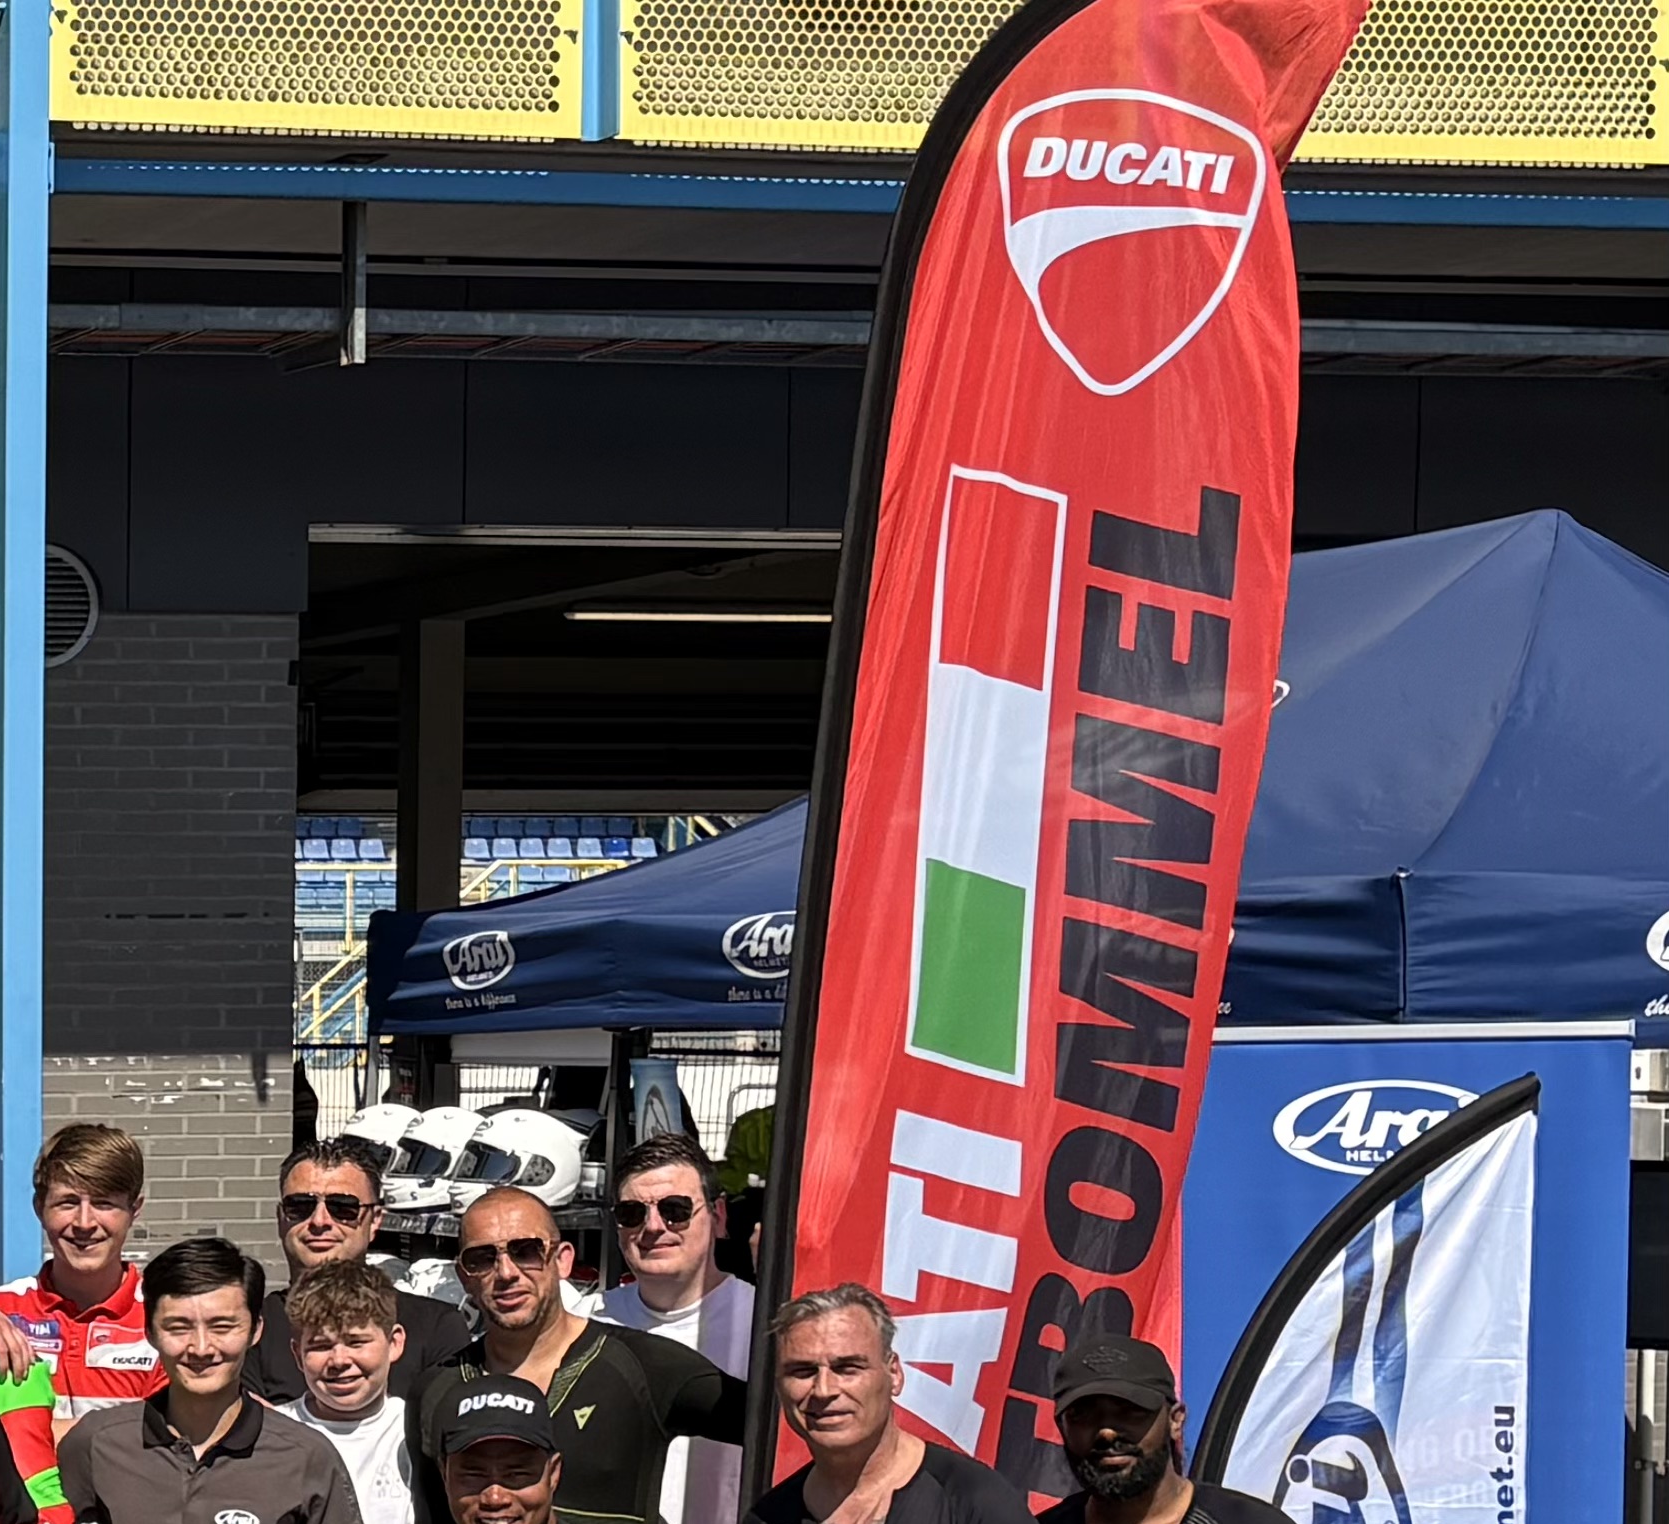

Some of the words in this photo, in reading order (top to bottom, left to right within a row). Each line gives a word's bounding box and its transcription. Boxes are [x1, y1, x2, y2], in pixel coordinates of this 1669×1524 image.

[1024, 137, 1235, 194] DUCATI
[452, 936, 507, 973] Arai
[732, 917, 794, 957] Ara
[1297, 1090, 1479, 1149] Ara
[112, 1355, 152, 1366] DUCATI
[457, 1393, 535, 1417] DUCATI
